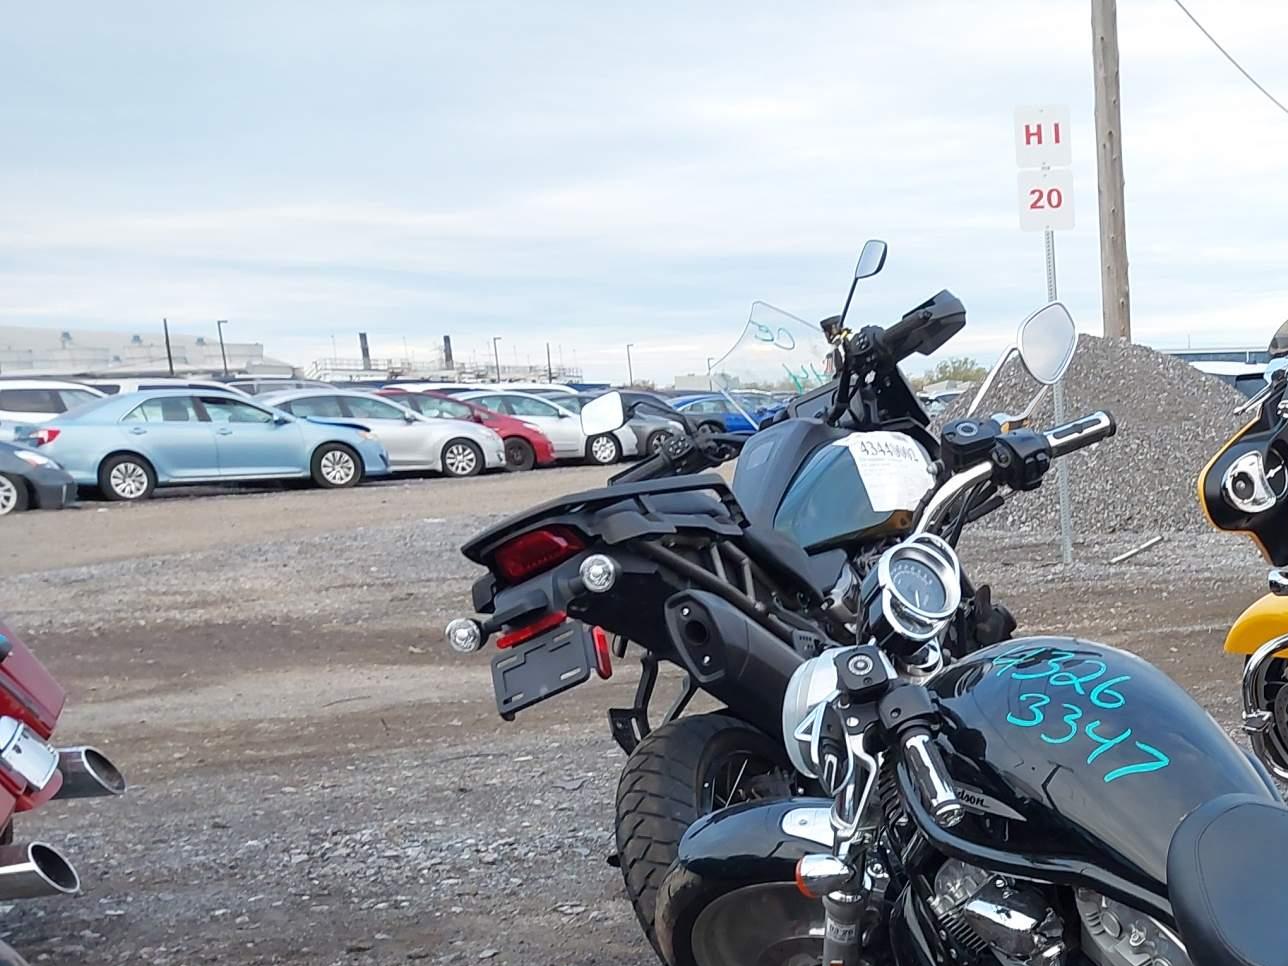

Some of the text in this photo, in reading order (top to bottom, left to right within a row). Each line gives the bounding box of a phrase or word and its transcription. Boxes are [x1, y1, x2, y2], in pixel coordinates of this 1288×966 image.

[1029, 188, 1063, 209] 20
[992, 646, 1131, 709] 4326
[1007, 693, 1170, 783] 3347
